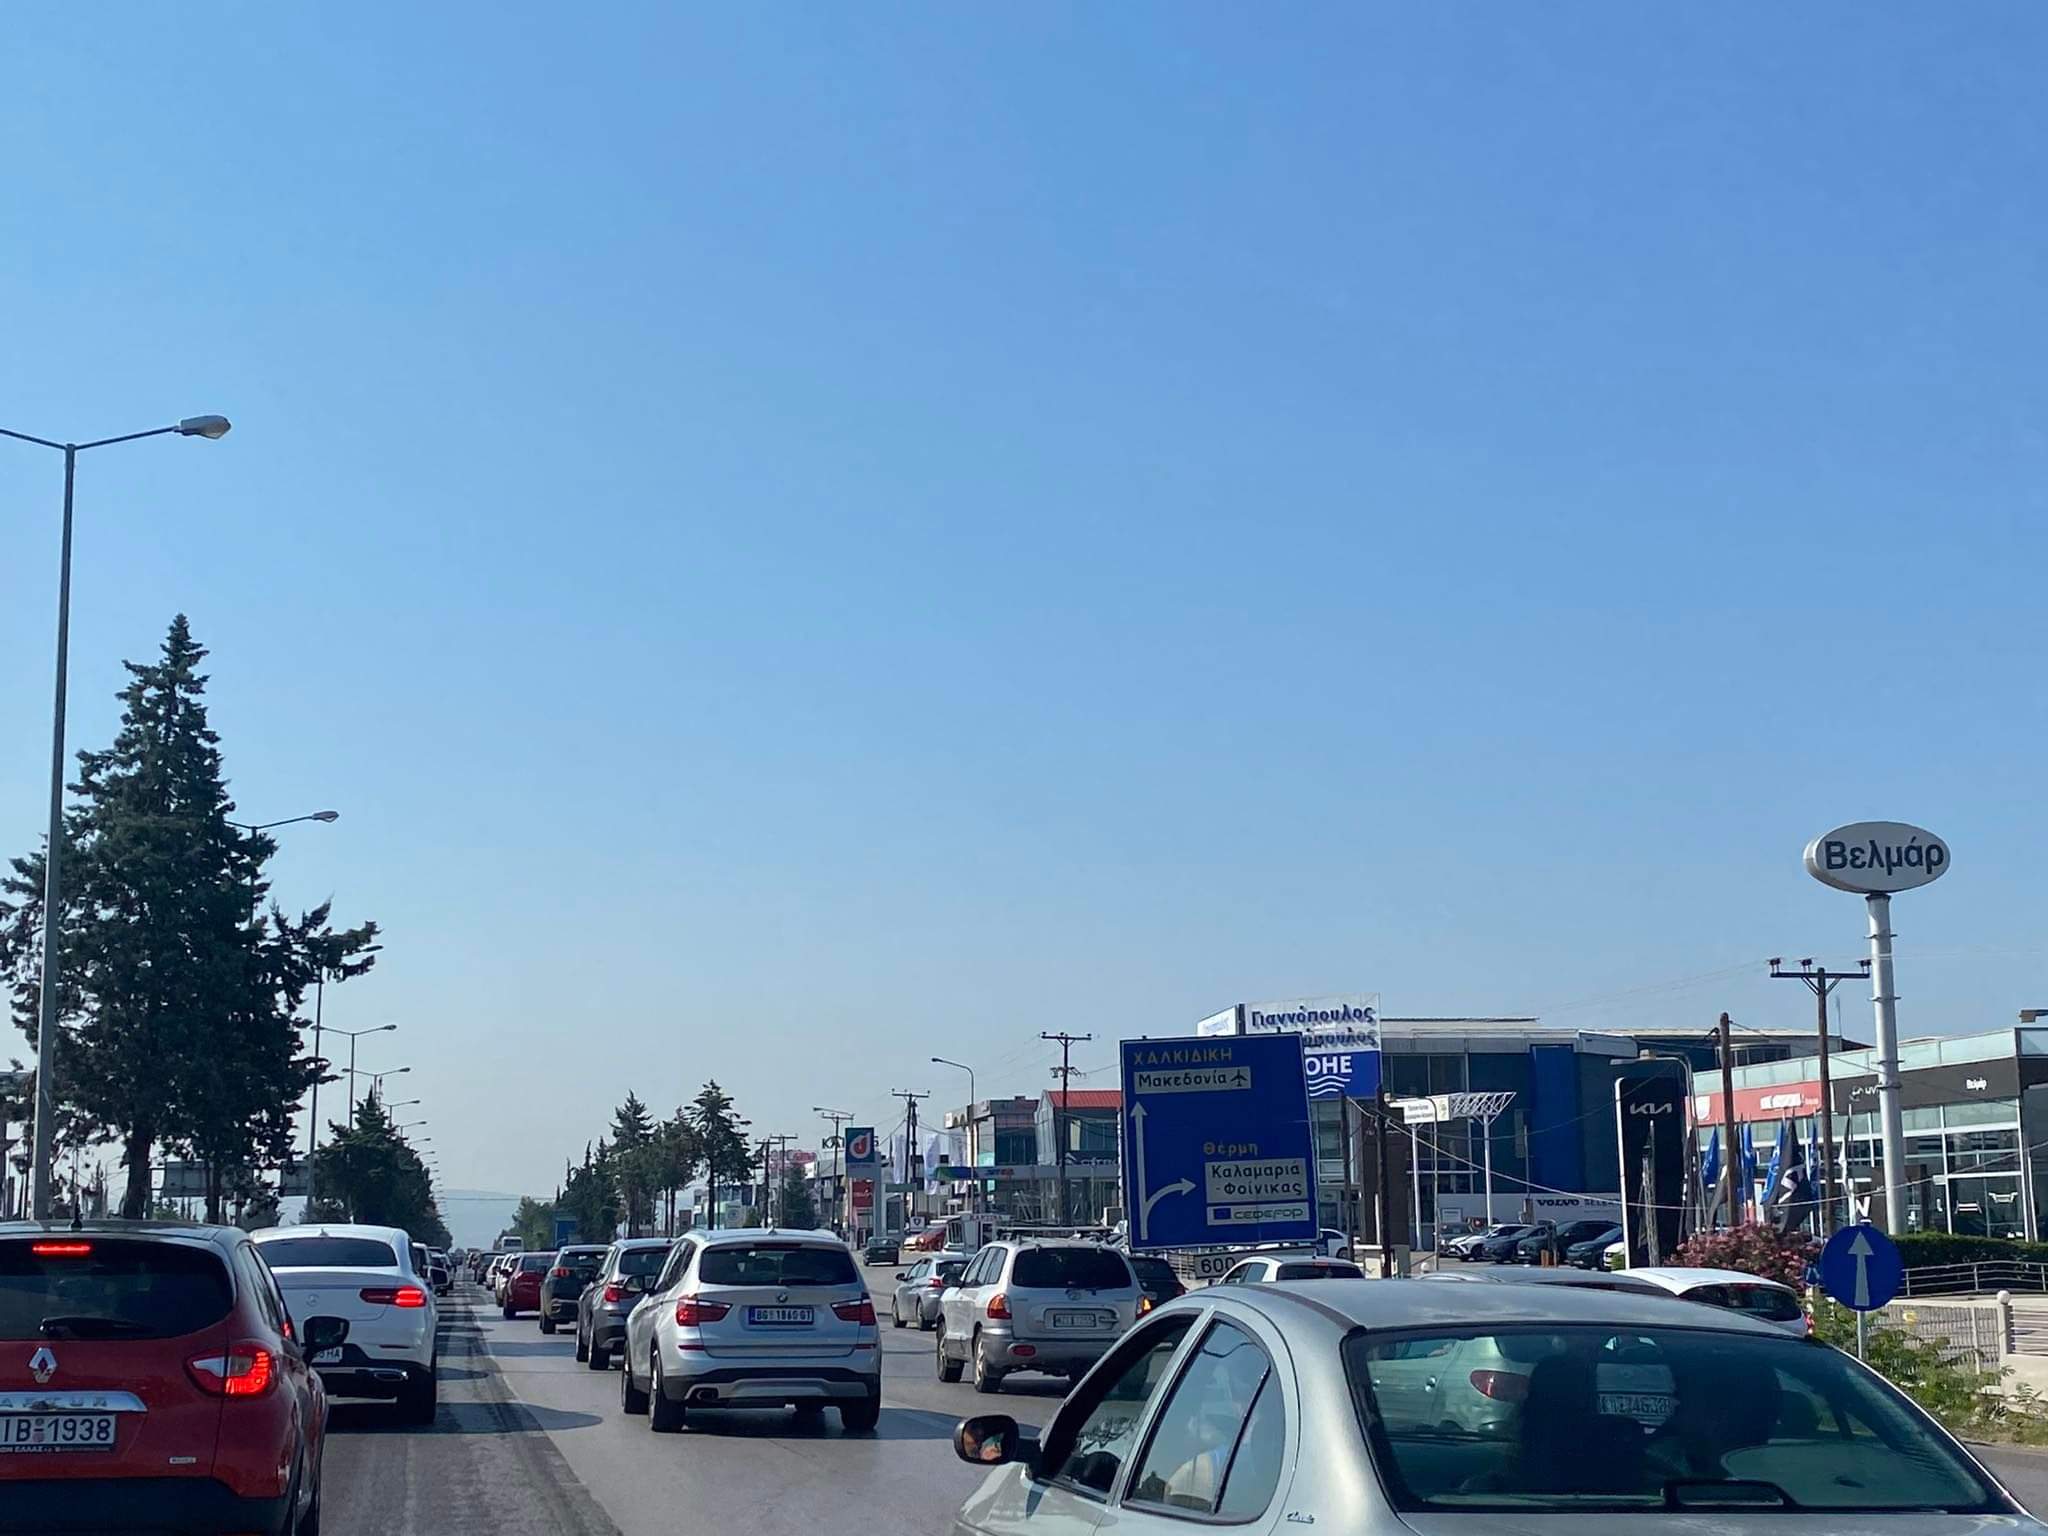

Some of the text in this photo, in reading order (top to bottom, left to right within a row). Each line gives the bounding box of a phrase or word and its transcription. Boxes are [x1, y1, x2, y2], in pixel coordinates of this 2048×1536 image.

[1825, 835, 1944, 876] Βελμάρ
[1251, 1004, 1377, 1028] Γιαννόπουλος
[1133, 1047, 1232, 1066] ΧΑΛΚΙΔΙΚΗ
[1306, 1056, 1352, 1075] OHE
[1138, 1072, 1228, 1088] Μακεδονία
[1629, 1103, 1673, 1115] KIA
[1203, 1141, 1258, 1158] Θέρμη
[1212, 1160, 1300, 1179] Καλαμαριά
[1537, 1199, 1580, 1207] VOLVO
[4, 1418, 111, 1442] IB-1938
